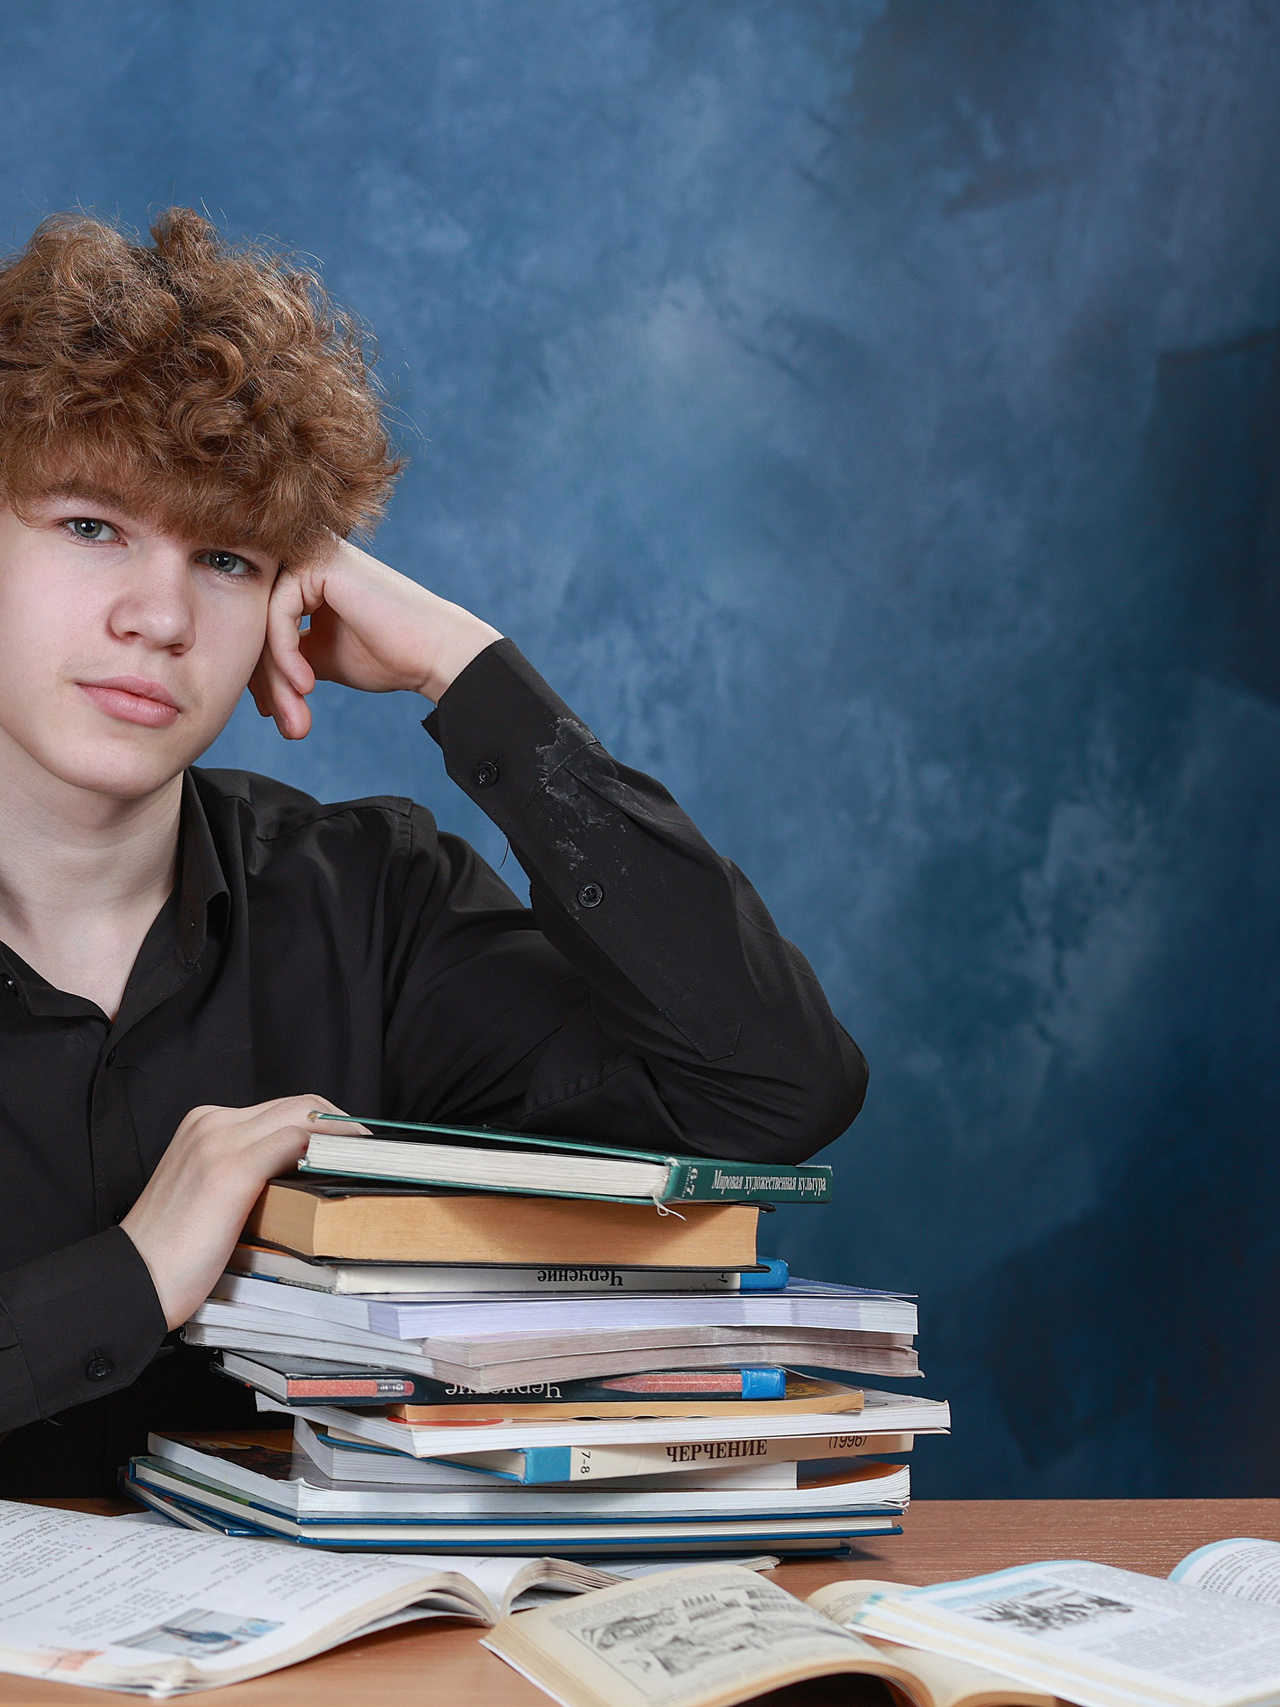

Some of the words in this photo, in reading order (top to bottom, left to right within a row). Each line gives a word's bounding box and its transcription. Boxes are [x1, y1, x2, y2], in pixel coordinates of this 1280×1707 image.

[711, 1169, 743, 1195] Мировая
[743, 1175, 797, 1196] художественная
[797, 1176, 827, 1197] культура
[537, 1269, 624, 1287] Черчение
[665, 1439, 768, 1463] ЧЕРЧЕНИЕ
